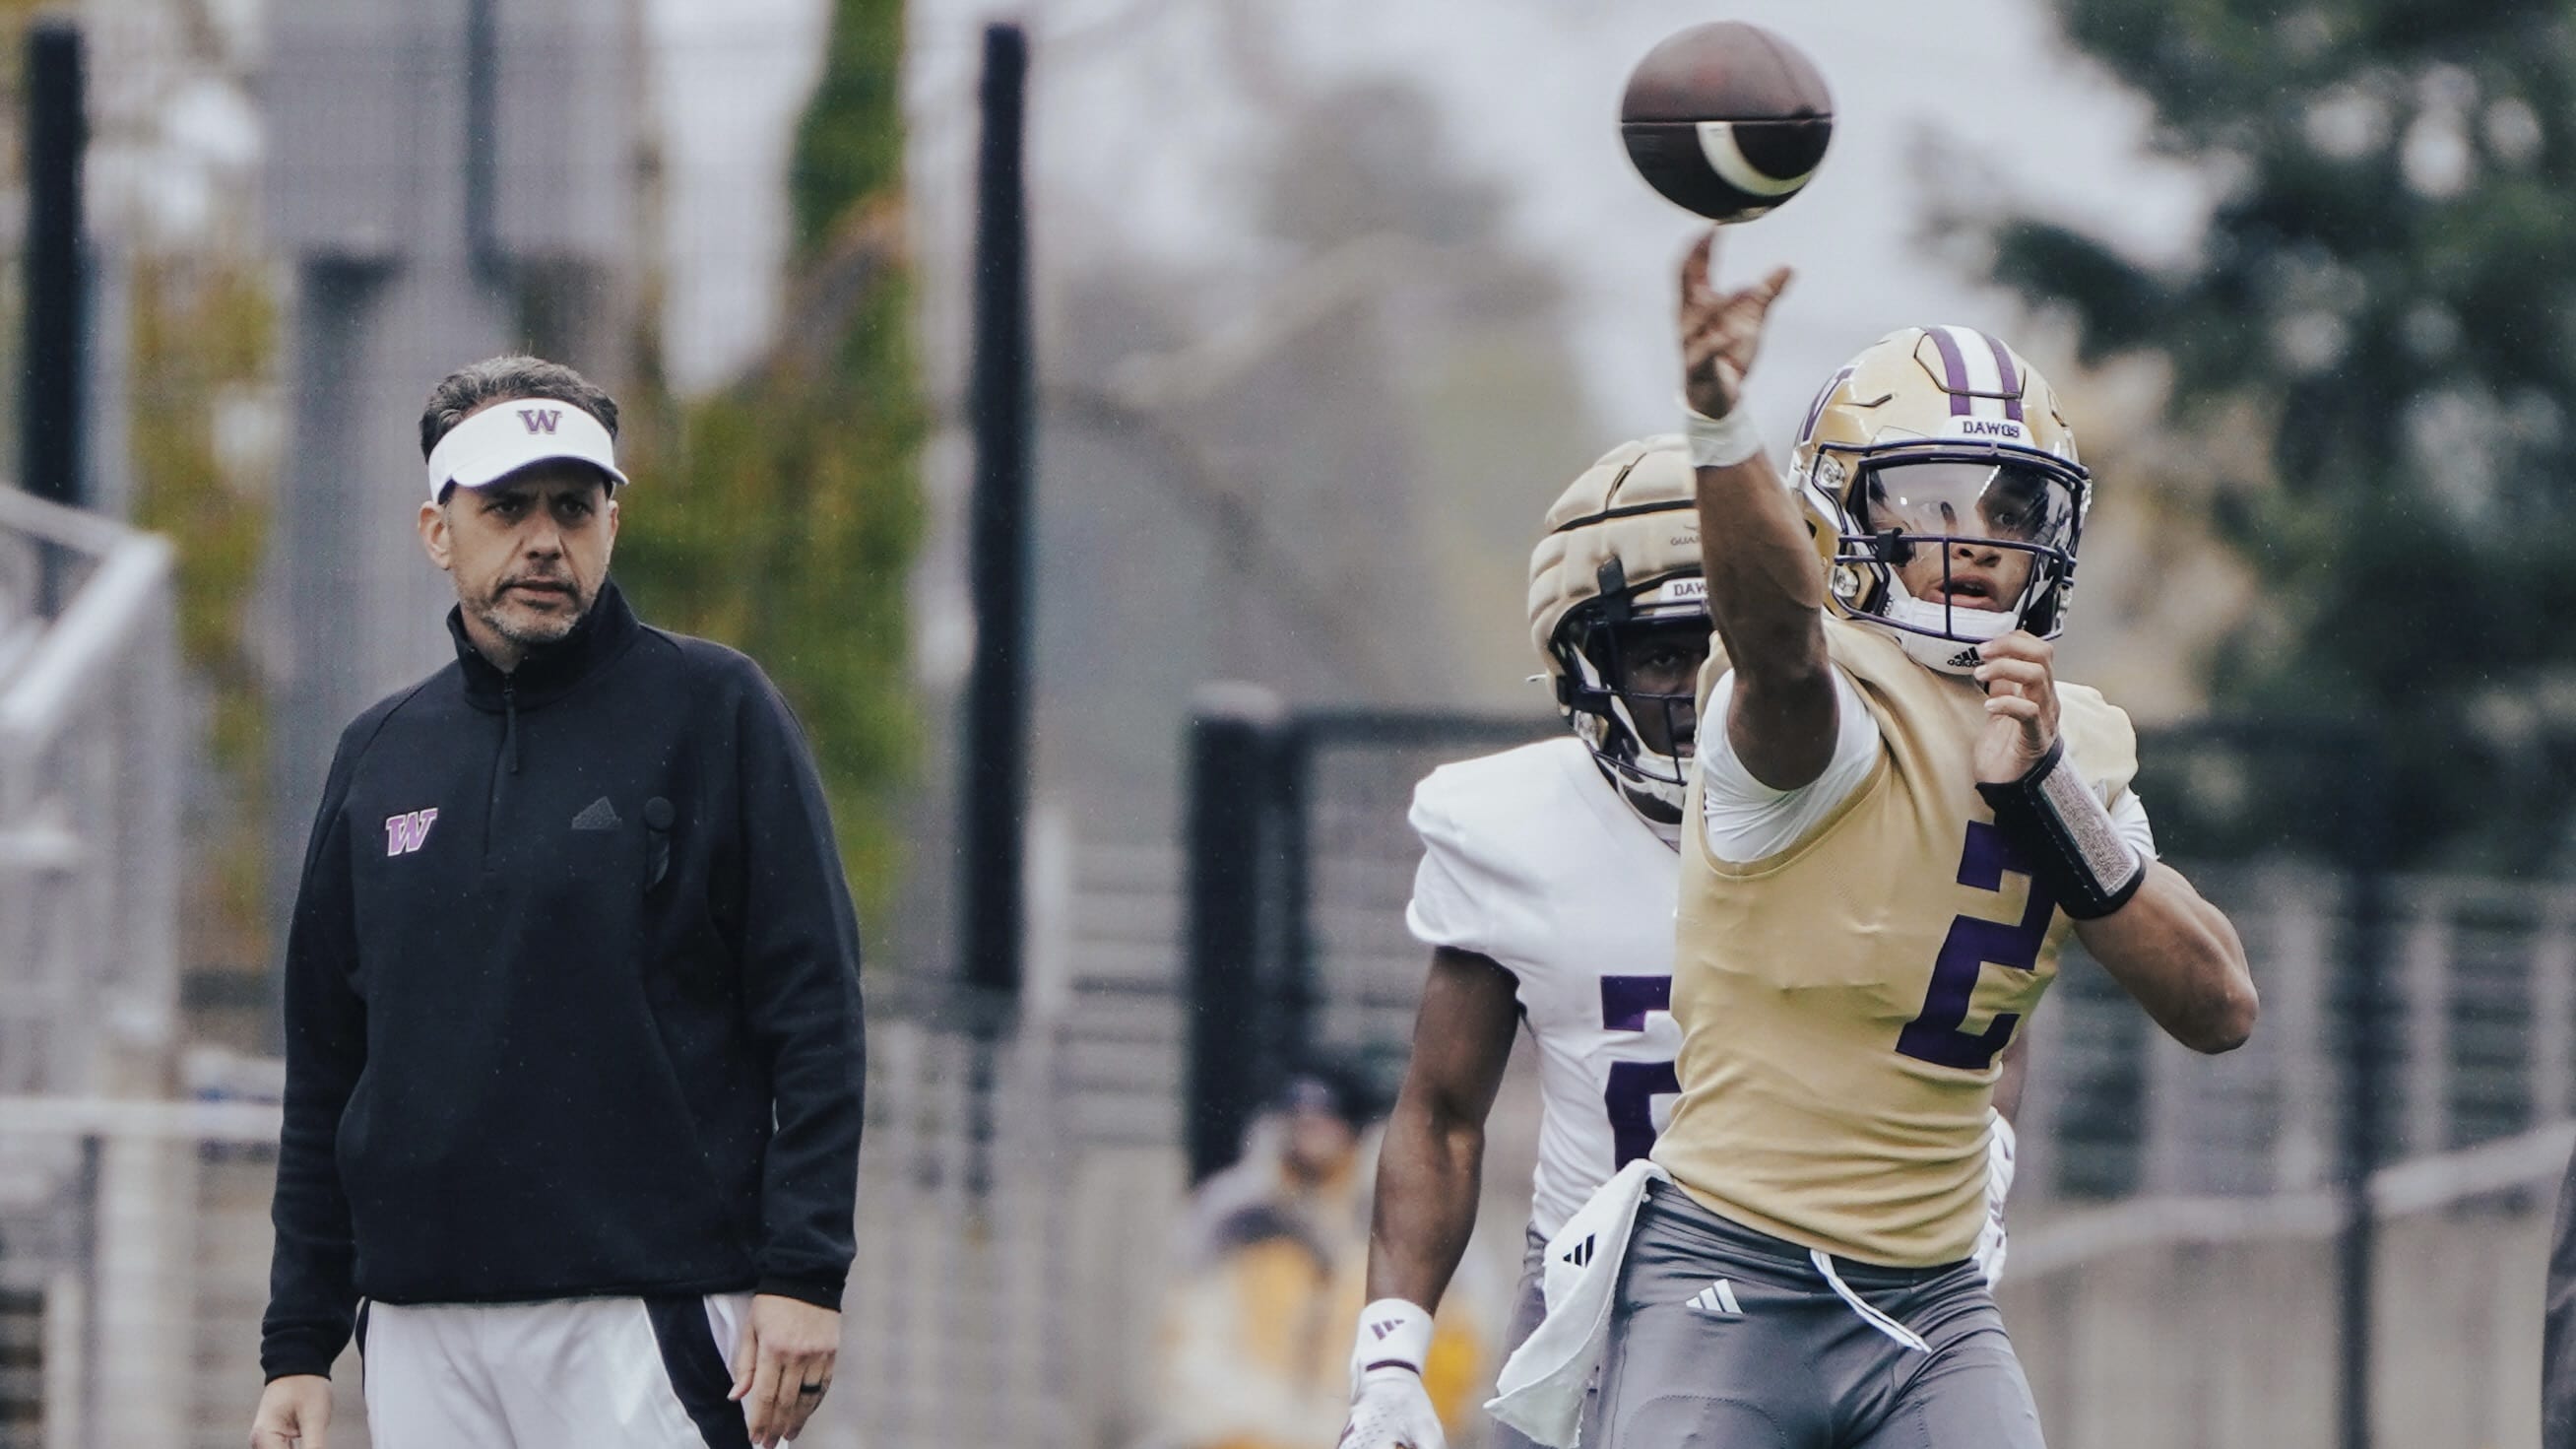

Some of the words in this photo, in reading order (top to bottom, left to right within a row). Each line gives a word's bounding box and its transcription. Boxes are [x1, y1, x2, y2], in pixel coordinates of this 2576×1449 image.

[516, 409, 563, 435] W
[1963, 420, 2020, 438] DAWGS
[385, 807, 439, 857] W
[1895, 820, 2057, 1070] 2
